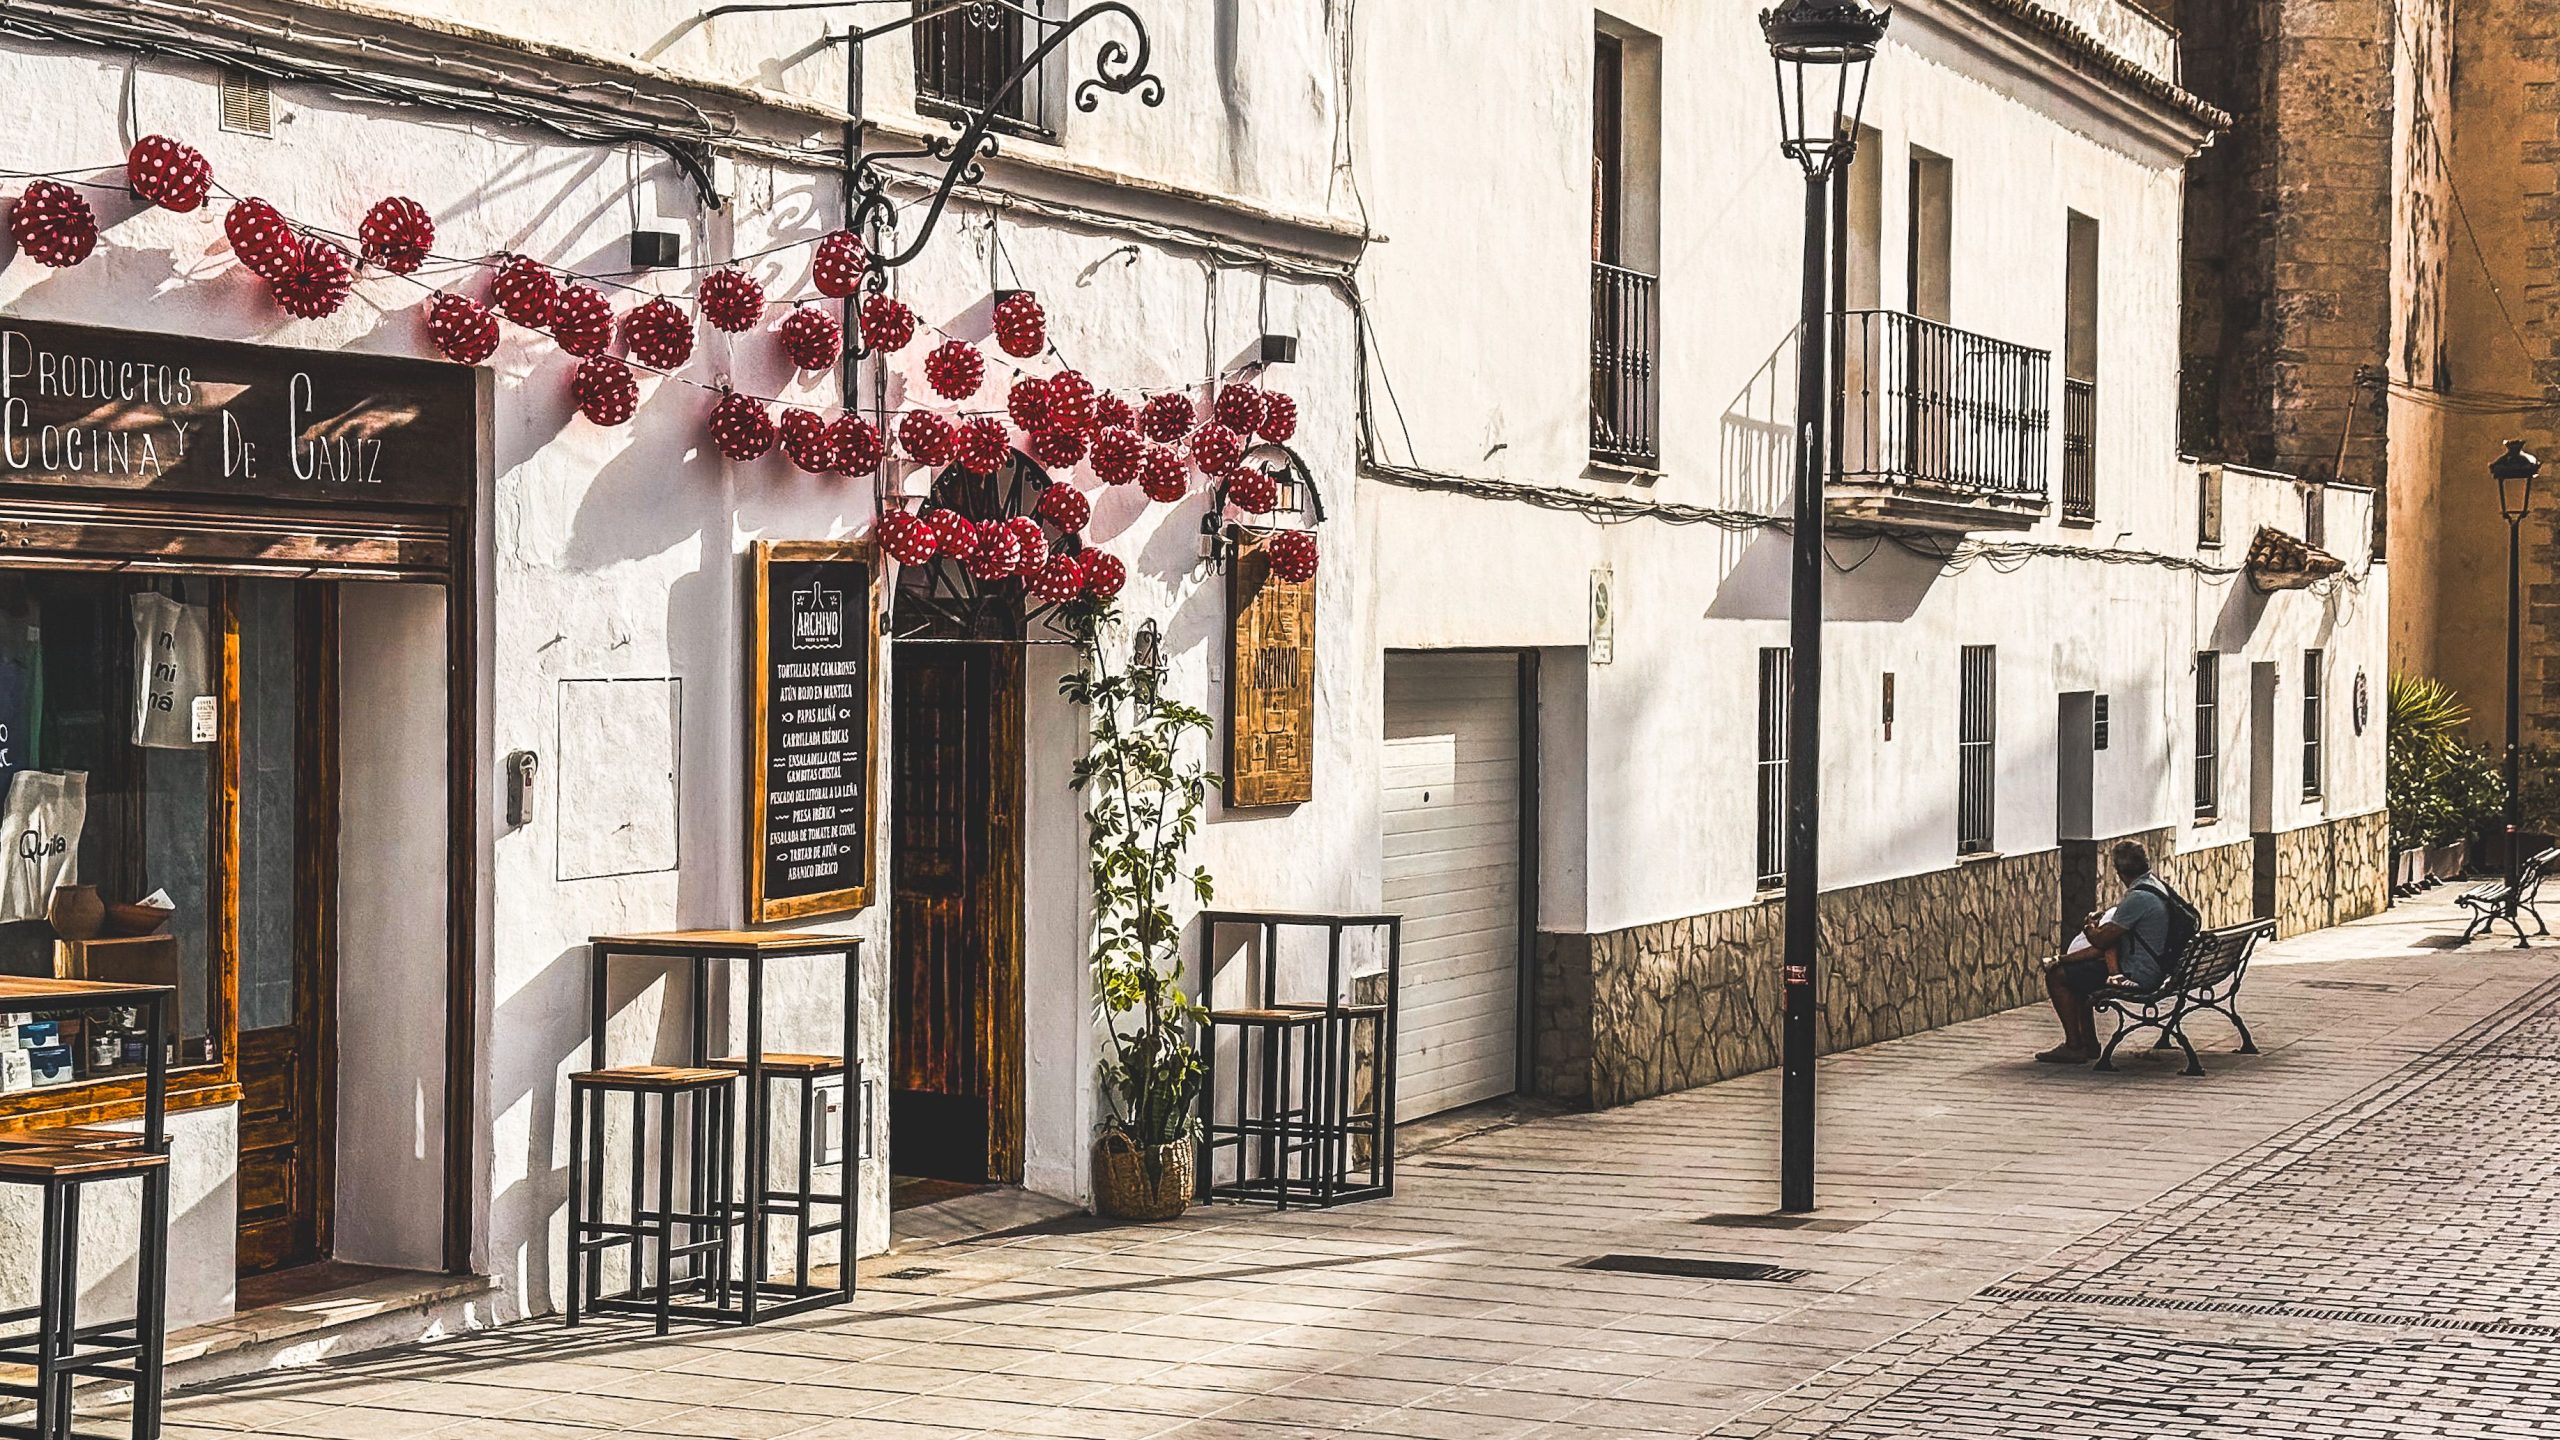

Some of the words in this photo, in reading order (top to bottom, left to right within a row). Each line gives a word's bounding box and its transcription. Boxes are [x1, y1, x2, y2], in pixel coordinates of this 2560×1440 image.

[2, 331, 191, 406] PRODUCTOS
[4, 398, 162, 476] COCINA
[172, 420, 188, 456] Y
[222, 409, 257, 479] DE
[290, 372, 382, 483] CADIZ
[797, 611, 838, 637] ARCHIVO
[777, 663, 811, 678] TORTILLAS
[811, 662, 820, 677] DE
[820, 661, 856, 676] CAMARONES
[1252, 646, 1298, 690] ARCHIVO
[780, 685, 796, 702] ATÚN
[814, 685, 823, 700] EN
[824, 684, 853, 699] MANTECA
[797, 708, 816, 724] PAPAS
[782, 731, 821, 748] CARRILLADA
[822, 727, 849, 744] IBÉRICAS
[788, 752, 828, 767] ENSALADILLA
[828, 751, 840, 764] CON
[787, 768, 818, 783] GAMBITAS
[818, 766, 842, 780] CRISTAL
[770, 790, 794, 804] PESCADO
[795, 790, 805, 802] DEL
[806, 787, 828, 801] LITORAL
[834, 786, 842, 798] LA
[842, 782, 858, 797] LEÑA
[792, 808, 811, 823] PRESA
[812, 804, 836, 820] IBÉRICA
[770, 830, 799, 846] ENSALADA
[800, 829, 807, 842] DE
[808, 826, 830, 840] TOMATE
[831, 826, 838, 838] DE
[839, 823, 856, 836] CONIL
[790, 846, 812, 862] TARTAR
[813, 846, 820, 859] DE
[822, 842, 838, 857] ATÚN
[788, 865, 814, 880] ABANICO
[815, 860, 838, 877] IBÉRICO
